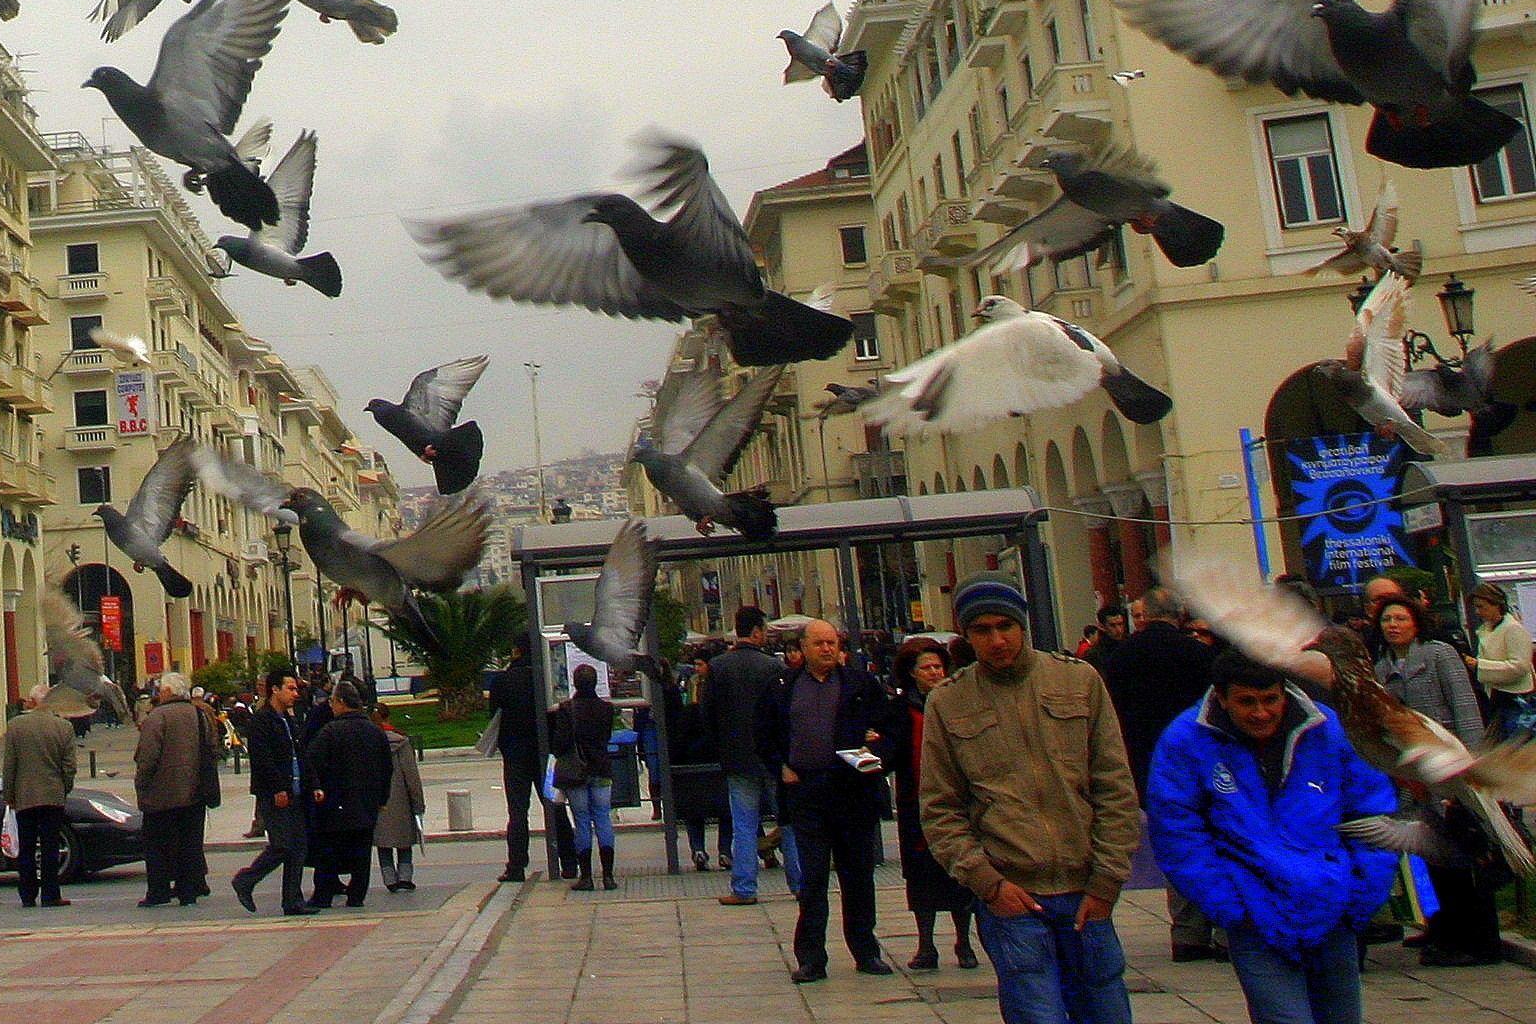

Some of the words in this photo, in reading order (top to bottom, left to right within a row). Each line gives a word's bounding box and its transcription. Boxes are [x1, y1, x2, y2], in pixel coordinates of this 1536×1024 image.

[1324, 533, 1392, 549] thessaloniki
[1324, 546, 1396, 560] international
[1329, 559, 1351, 571] film
[1352, 556, 1395, 570] festival
